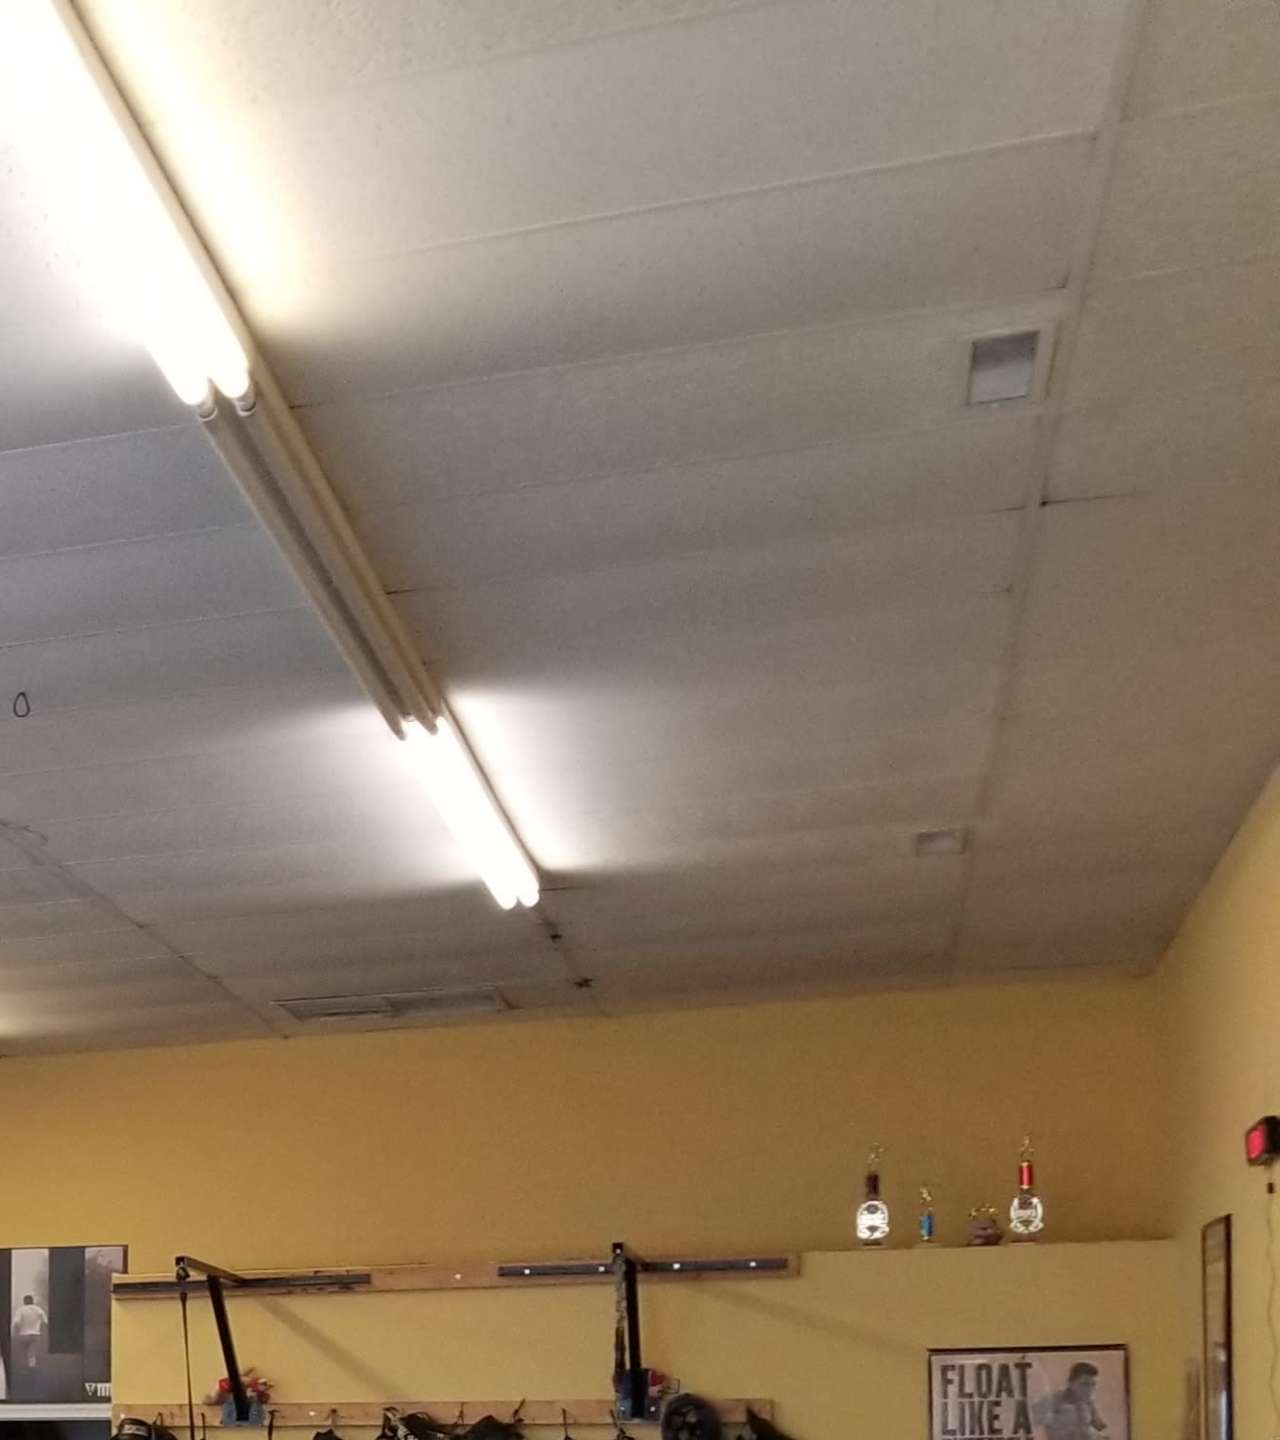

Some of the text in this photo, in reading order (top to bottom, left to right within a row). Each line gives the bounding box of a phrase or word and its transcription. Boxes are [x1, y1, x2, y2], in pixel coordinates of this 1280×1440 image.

[941, 1362, 1032, 1399] FLOAT
[941, 1401, 1032, 1436] LIKE A
